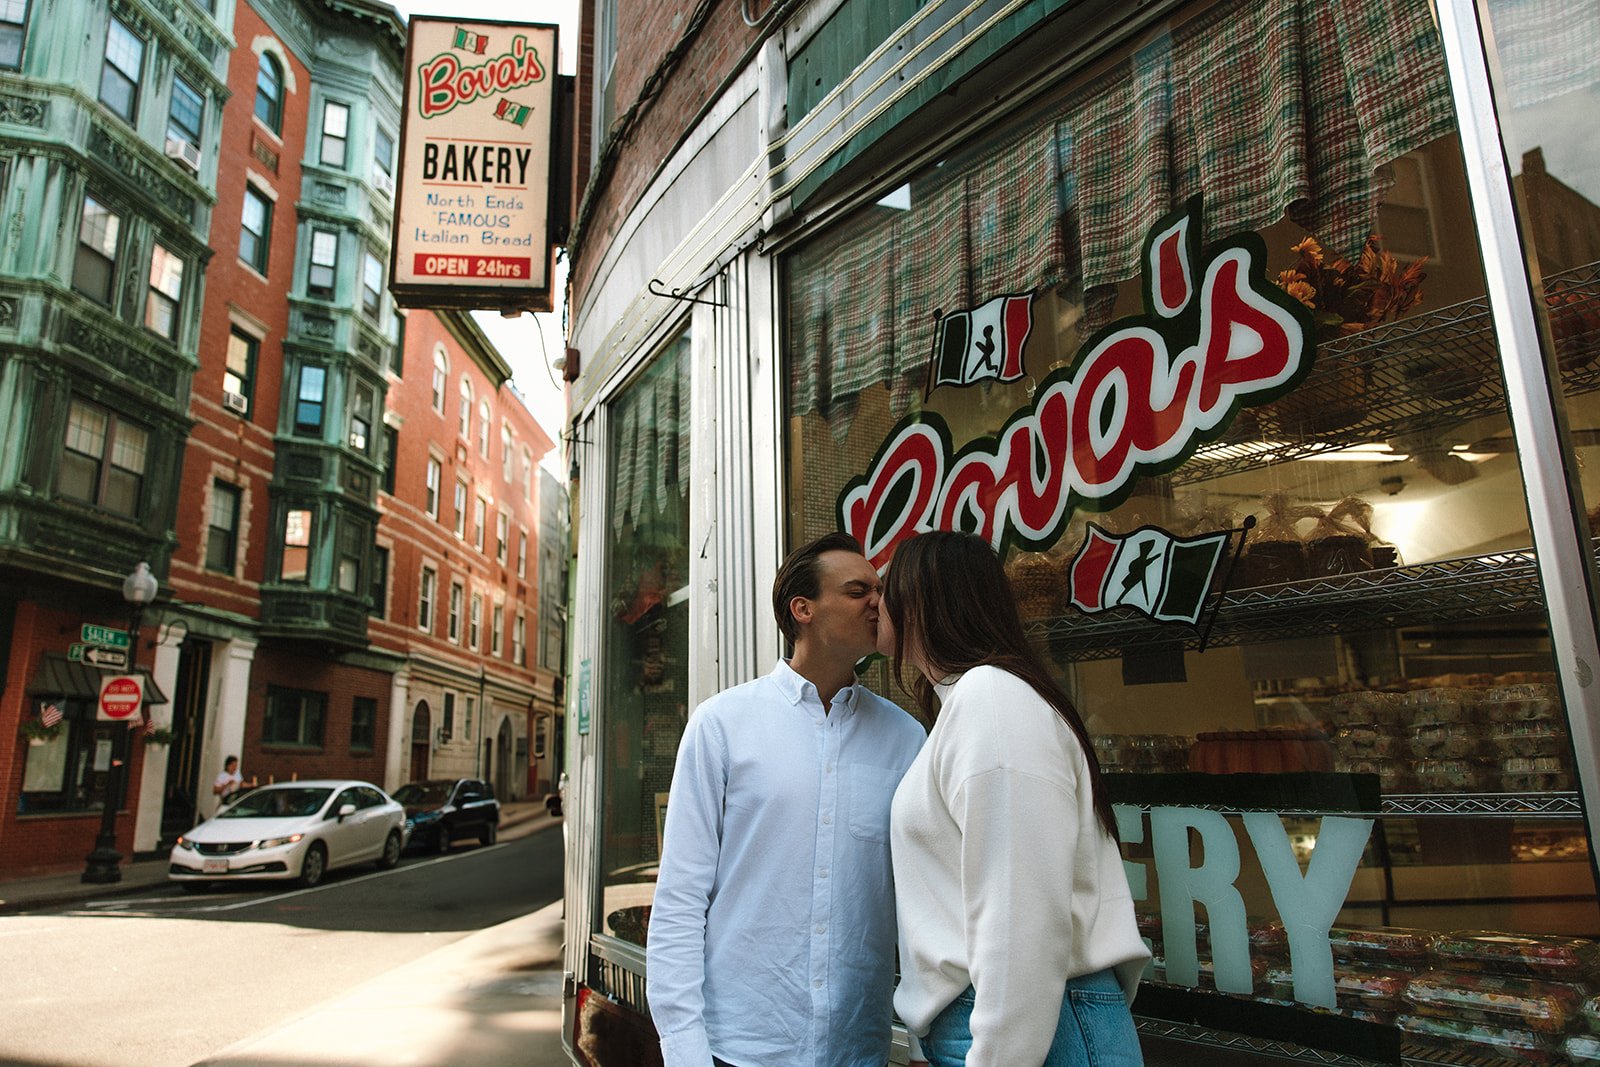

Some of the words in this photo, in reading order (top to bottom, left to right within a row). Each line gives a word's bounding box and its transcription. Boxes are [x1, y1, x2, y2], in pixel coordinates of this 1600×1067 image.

[419, 35, 546, 119] Bova's
[423, 143, 531, 184] BAKERY
[426, 193, 475, 208] North
[415, 227, 469, 244] Italian
[481, 230, 532, 247] Bread
[425, 257, 469, 275] OPEN
[476, 260, 521, 277] 24hrs
[121, 684, 135, 693] NOT
[107, 704, 130, 712] ENTER
